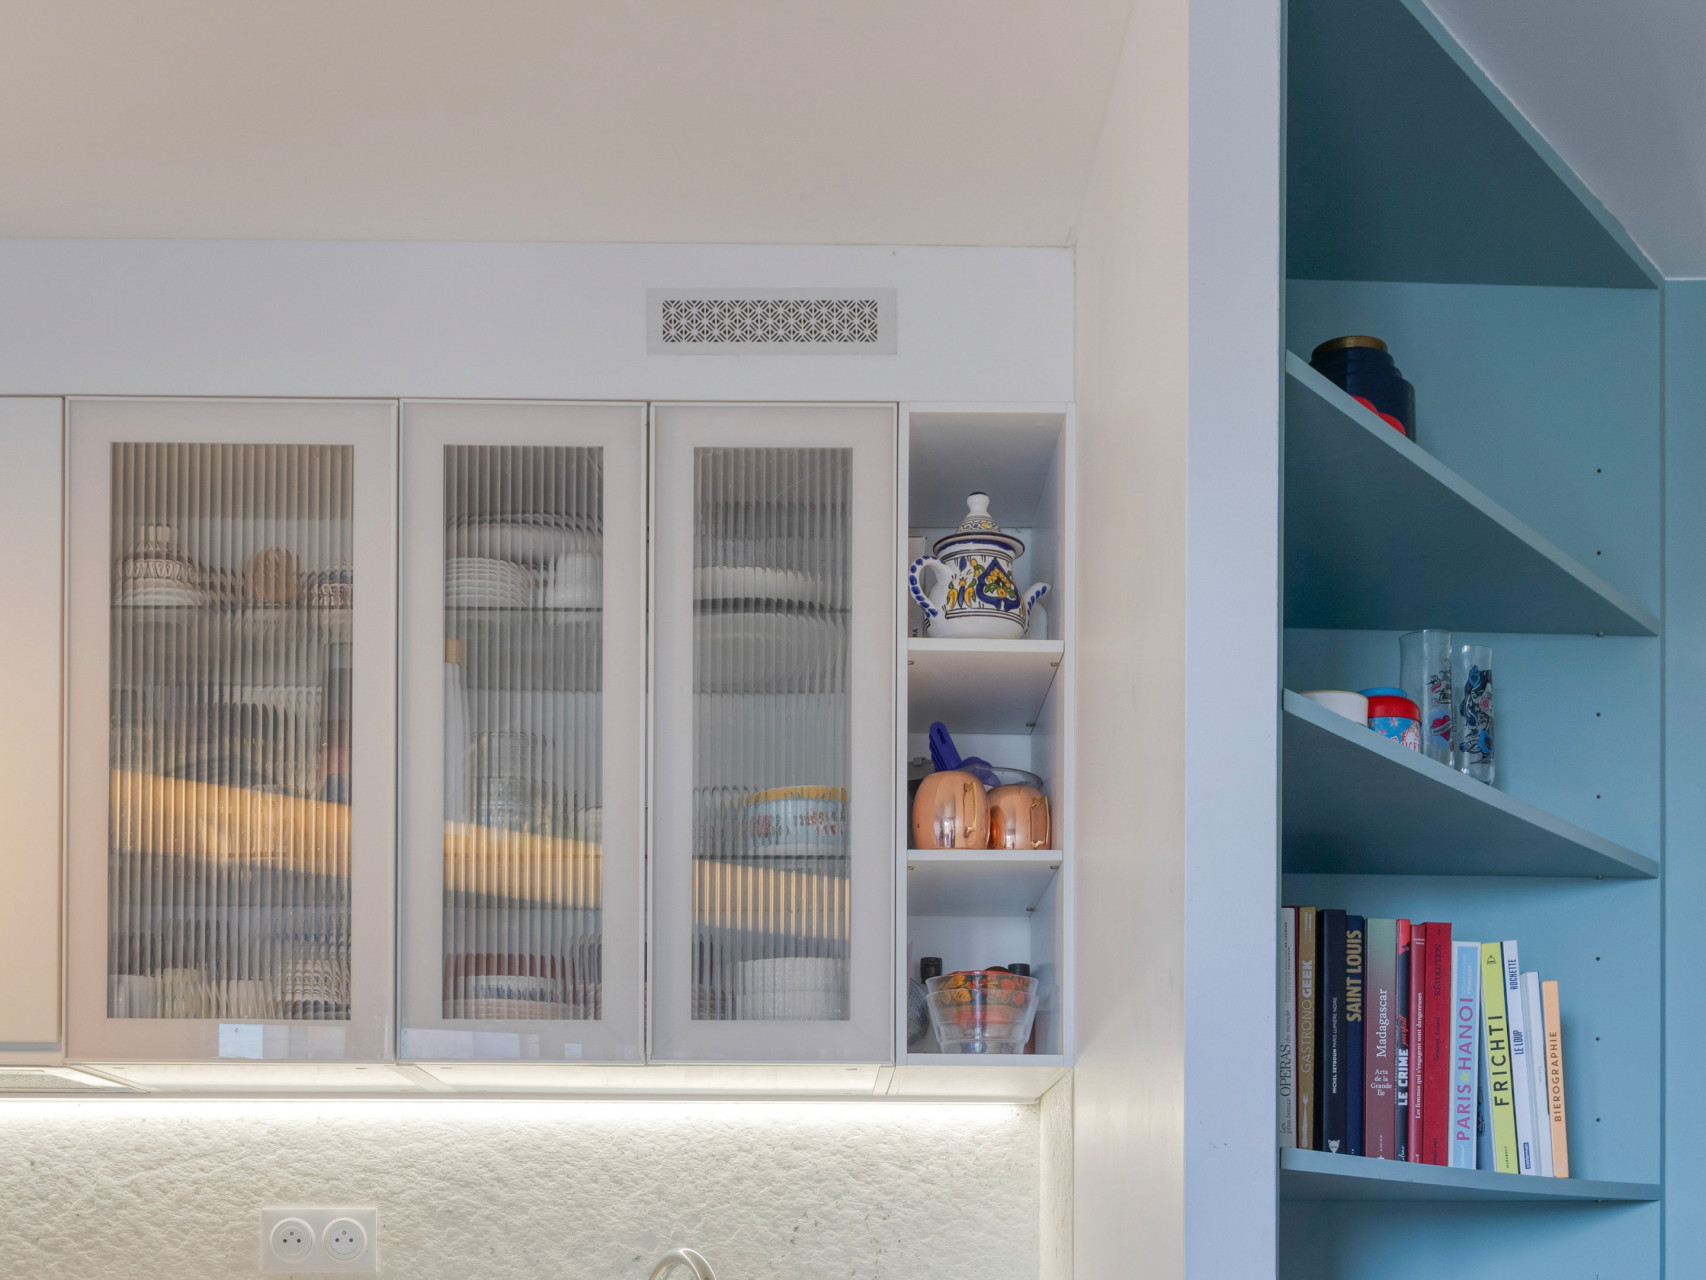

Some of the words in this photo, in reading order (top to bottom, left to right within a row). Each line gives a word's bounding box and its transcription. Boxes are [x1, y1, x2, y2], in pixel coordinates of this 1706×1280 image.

[1345, 929, 1361, 973] LOUIS
[1509, 958, 1517, 990] ROCHETTE
[1344, 976, 1362, 1022] SAINT
[1415, 992, 1423, 1028] dangereuses
[1376, 988, 1388, 1058] Madagascar
[1399, 1013, 1409, 1046] parfait
[1458, 998, 1474, 1070] HANOI
[1513, 1030, 1523, 1046] LOUP
[1397, 1048, 1408, 1087] CRIME
[1488, 1015, 1510, 1106] FRICHTI
[1514, 1046, 1524, 1055] LE
[1549, 1031, 1562, 1122] BIEROGRAPHIE
[1397, 1091, 1408, 1106] LE
[1456, 1084, 1471, 1141] PARIS
